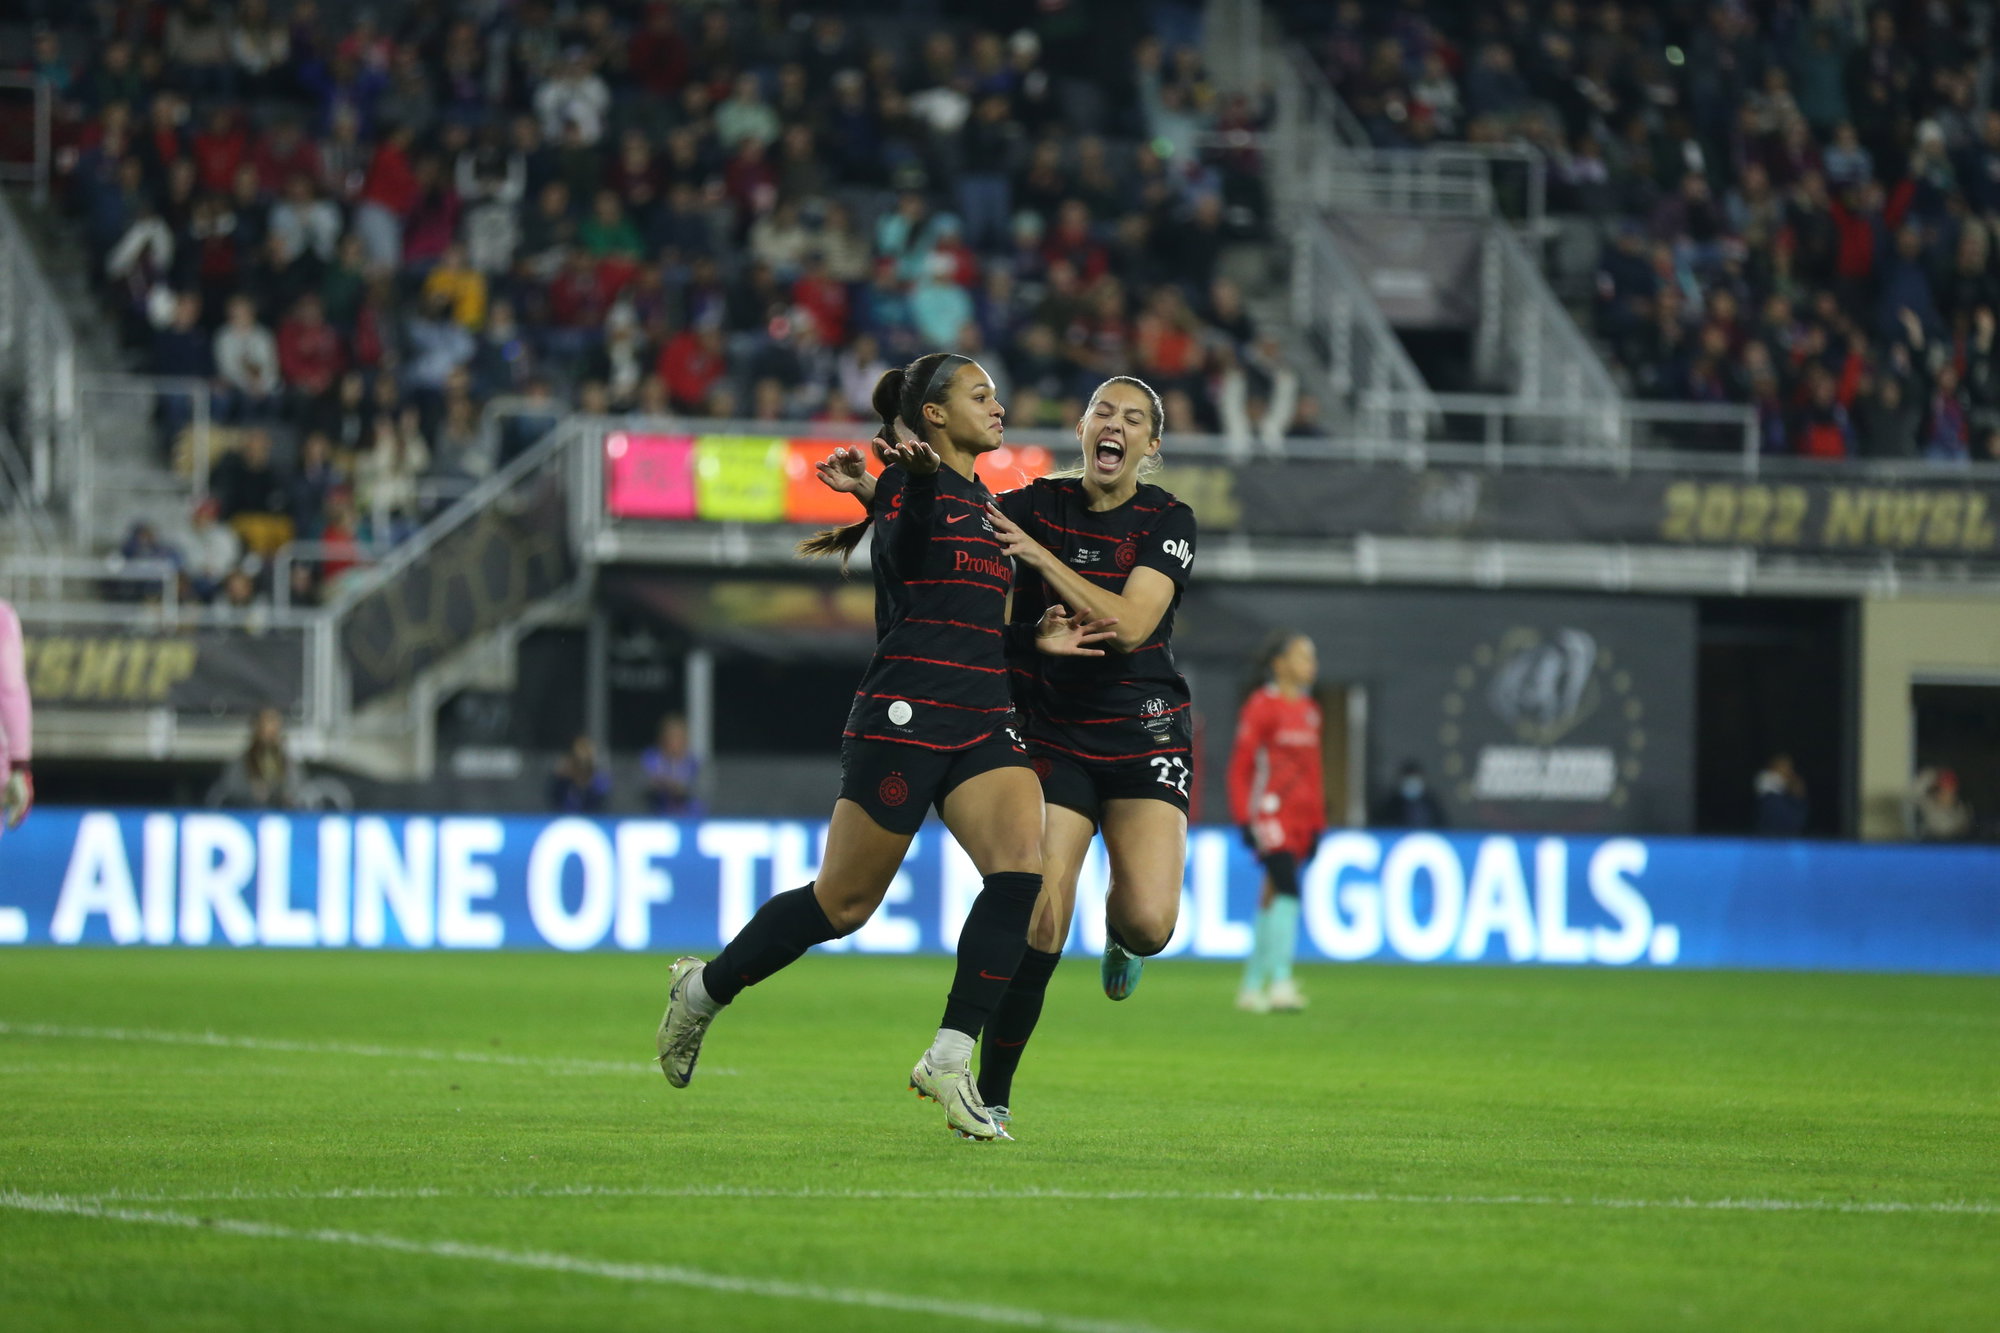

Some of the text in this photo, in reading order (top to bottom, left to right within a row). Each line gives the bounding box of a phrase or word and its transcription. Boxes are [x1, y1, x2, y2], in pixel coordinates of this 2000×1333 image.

[1820, 487, 1994, 546] NWSL
[1162, 538, 1194, 569] ally
[24, 635, 199, 700] SHIP
[1150, 756, 1189, 800] 22
[49, 811, 505, 948] AIRLINE
[526, 815, 681, 951] OF
[1303, 831, 1680, 964] GOALS.
